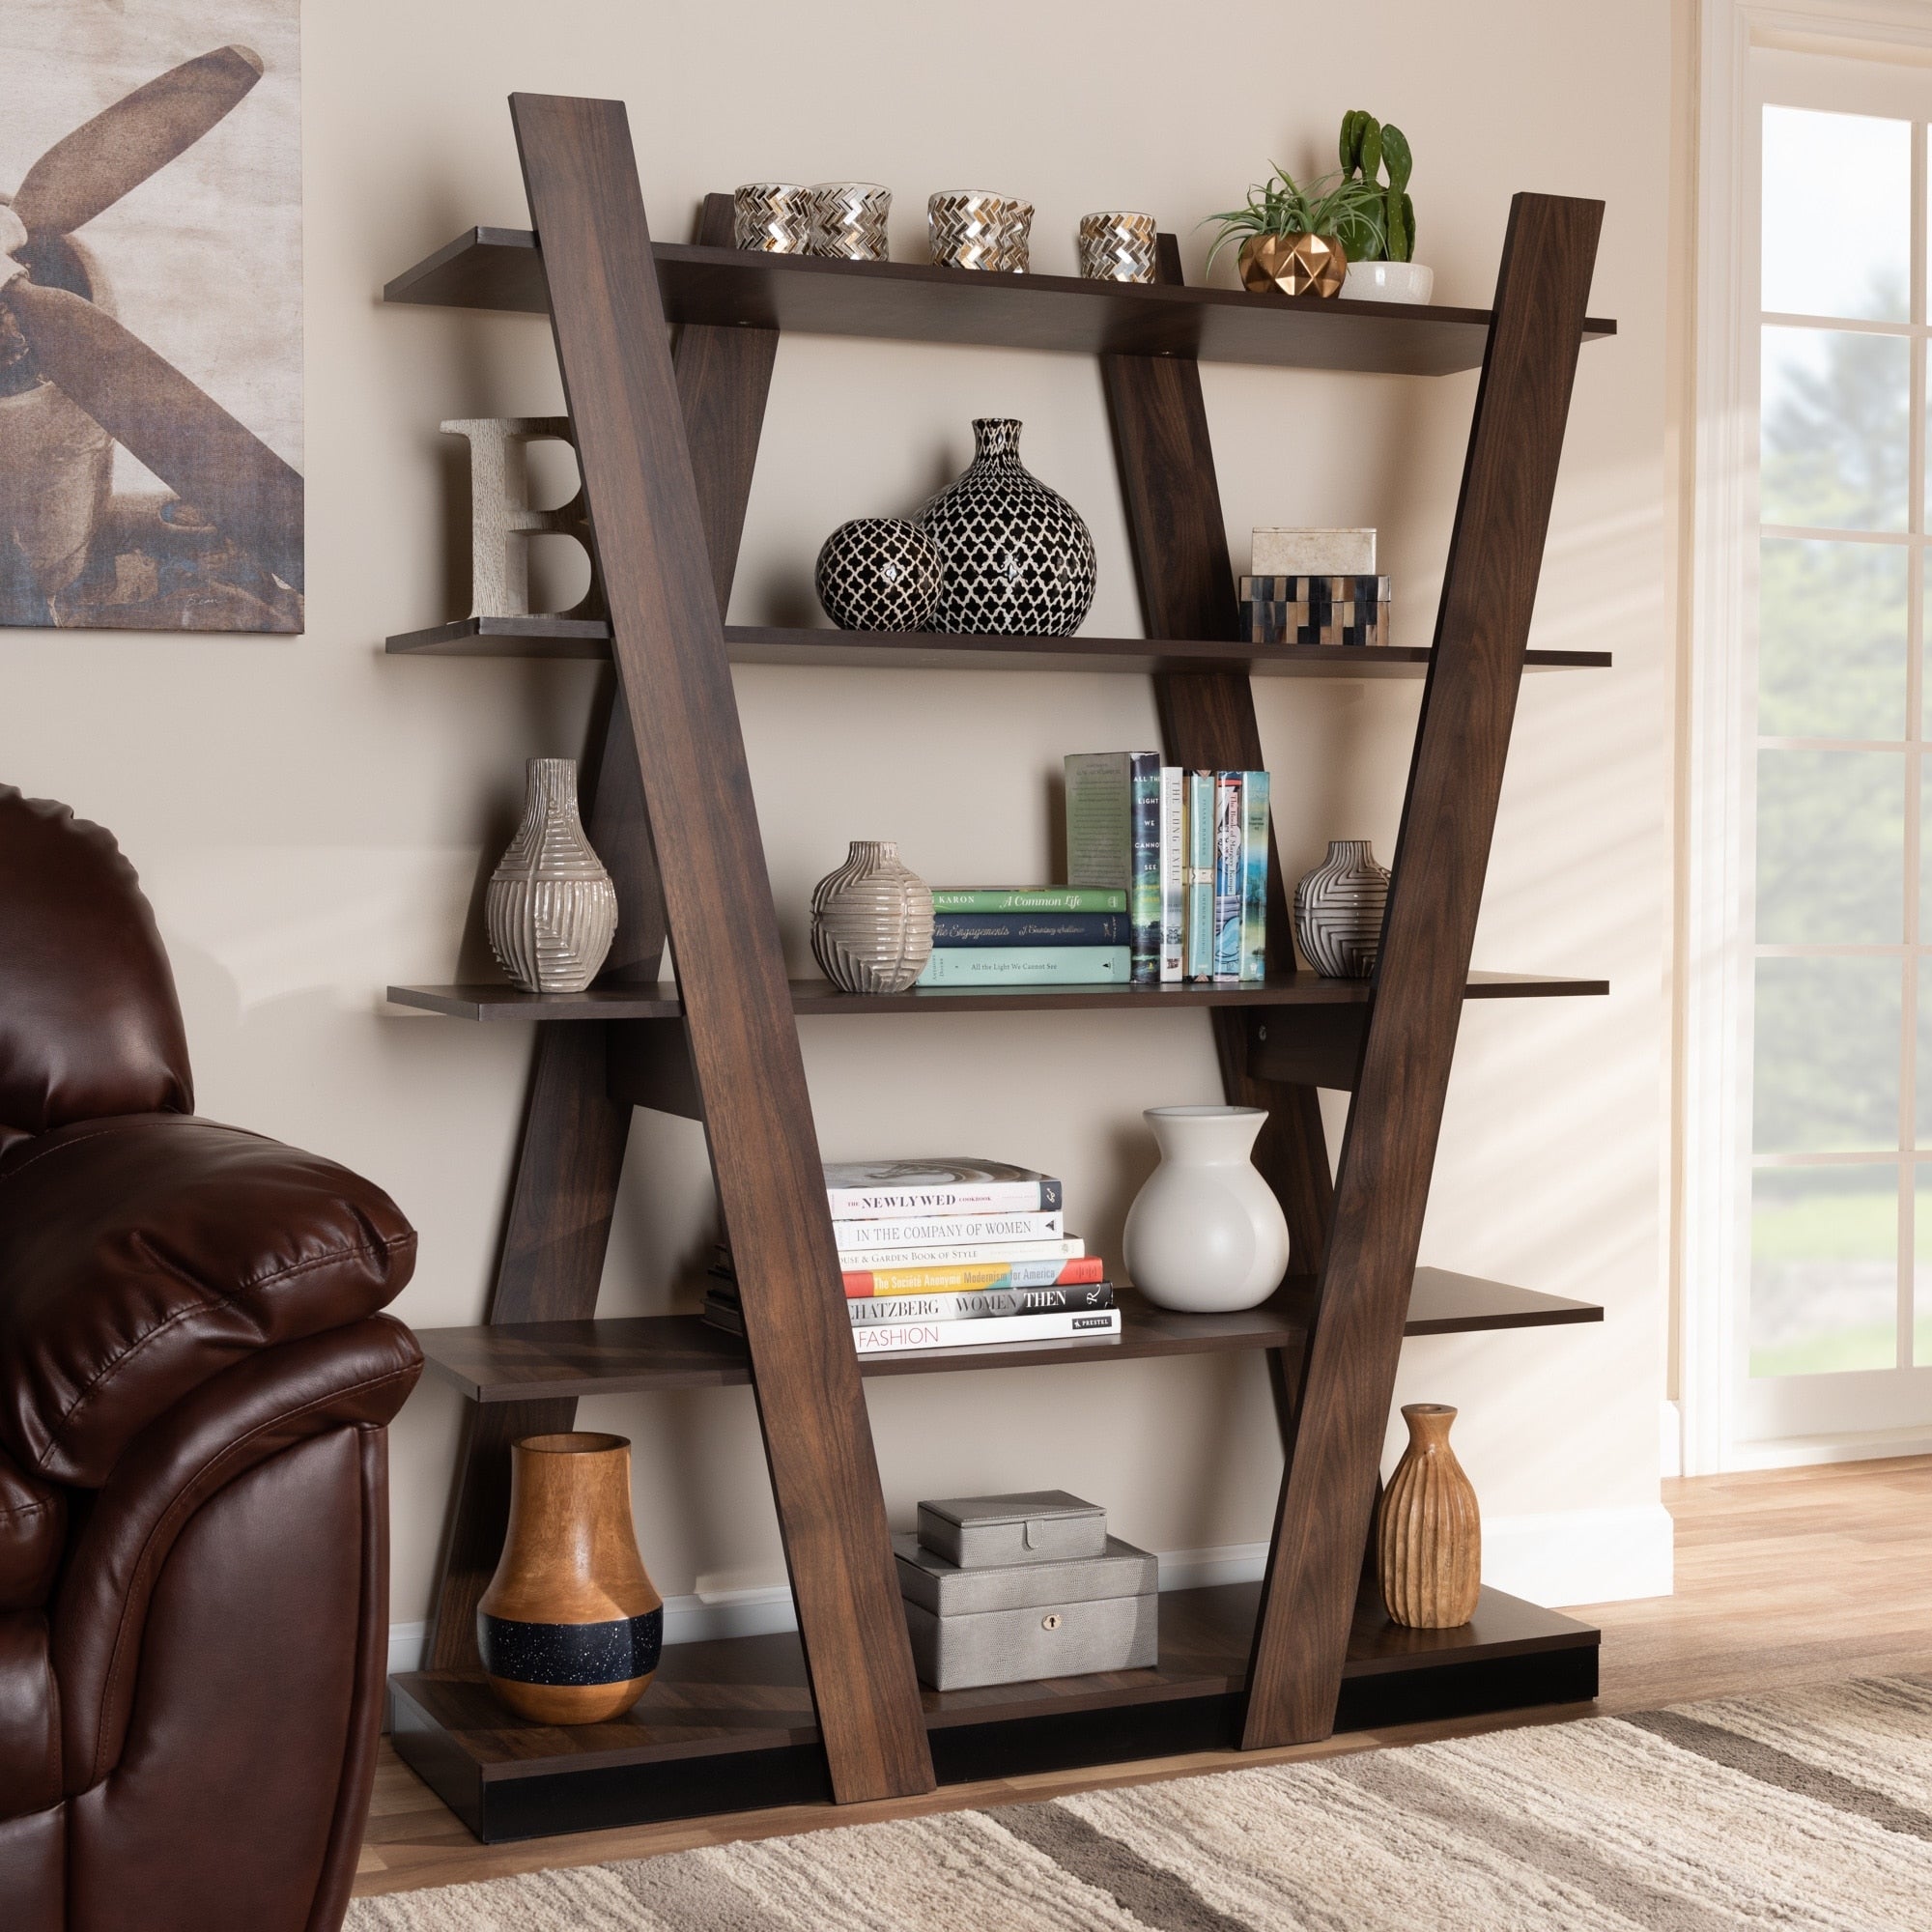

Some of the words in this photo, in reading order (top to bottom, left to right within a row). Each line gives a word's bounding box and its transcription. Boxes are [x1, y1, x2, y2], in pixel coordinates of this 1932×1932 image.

[939, 895, 975, 904] KARON
[999, 895, 1012, 909] A
[1014, 895, 1062, 907] Common
[1064, 895, 1082, 909] Life
[949, 923, 1010, 940] Engagements
[993, 963, 1010, 972] Light
[862, 1194, 956, 1209] NEWLYWED
[857, 1229, 869, 1241] IN
[873, 1227, 900, 1241] THE
[903, 1224, 963, 1239] COMPANY
[966, 1223, 982, 1236] OF
[985, 1220, 1032, 1235] WOMEN
[871, 1253, 908, 1264] GARDEN
[911, 1252, 937, 1261] BOOK
[938, 1251, 950, 1260] OF
[952, 1250, 979, 1259] STYLE
[874, 1276, 889, 1291] The
[964, 1269, 1009, 1284] Modernism
[1023, 1267, 1056, 1280] America
[849, 1299, 939, 1320] HATZBERG
[956, 1294, 1016, 1312] WOMEN
[1024, 1290, 1066, 1308] THEN
[1082, 1319, 1109, 1327] PRESTEL
[859, 1326, 939, 1348] FASHION
